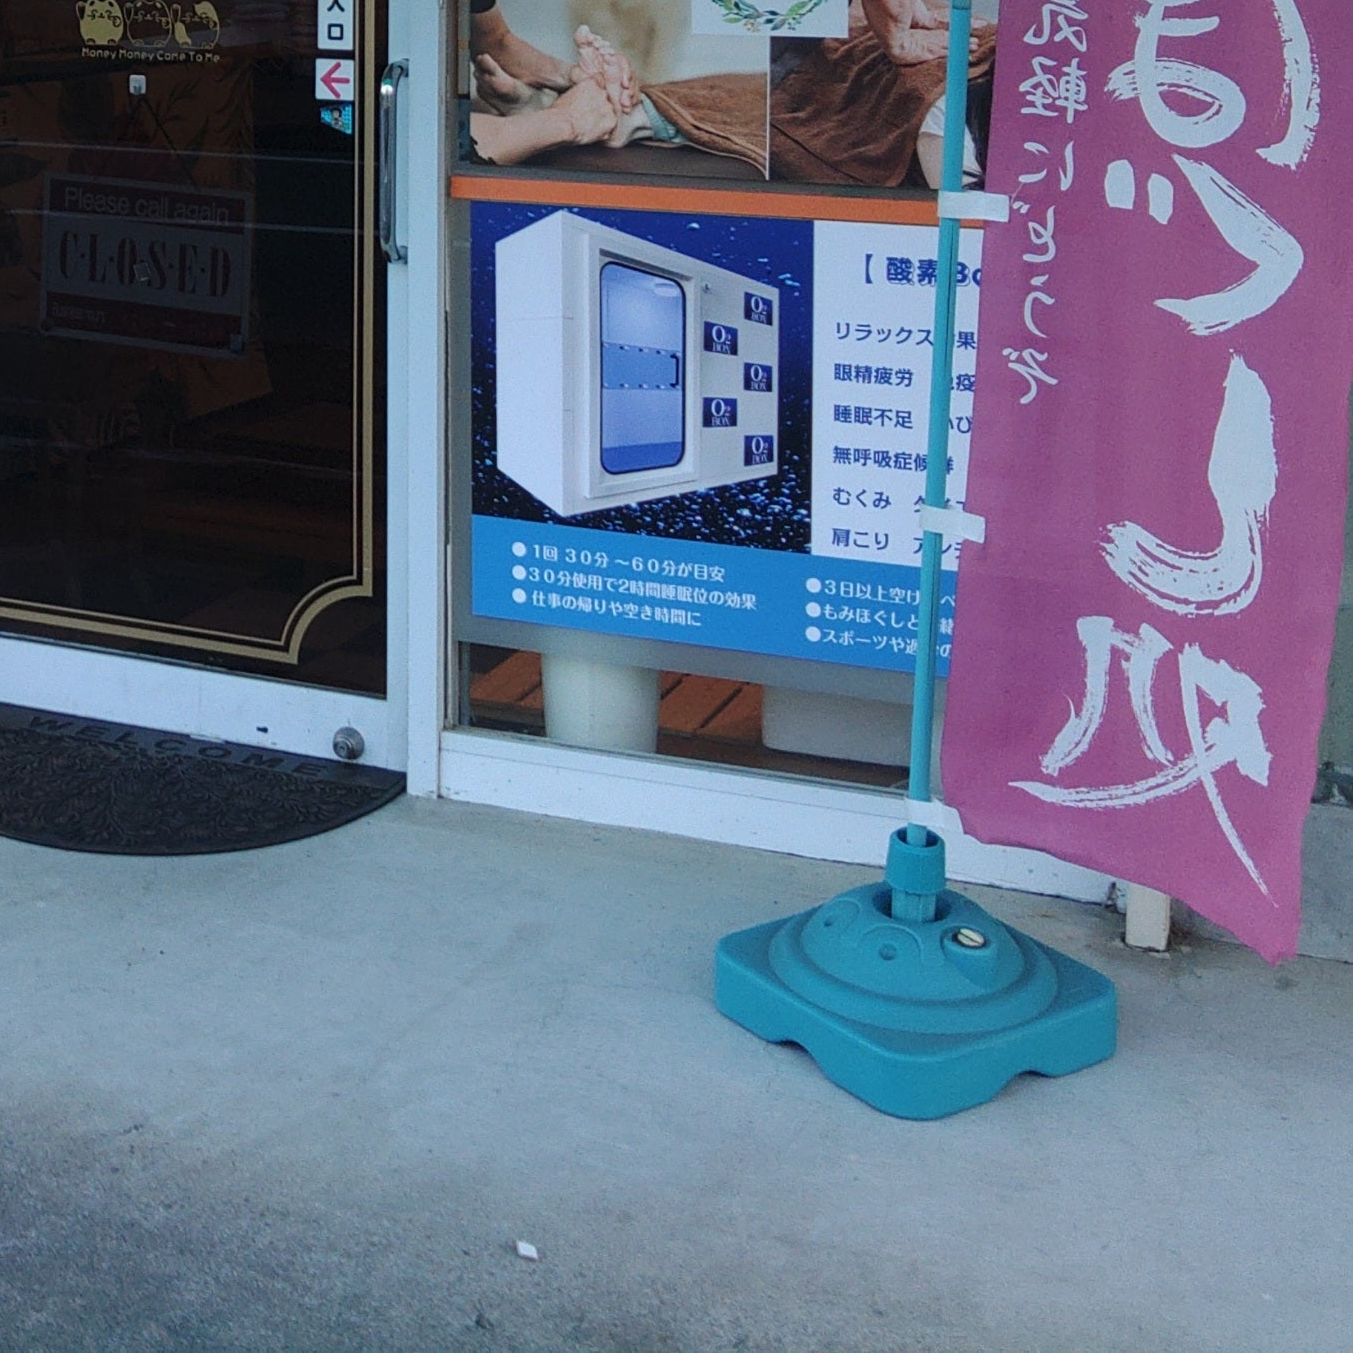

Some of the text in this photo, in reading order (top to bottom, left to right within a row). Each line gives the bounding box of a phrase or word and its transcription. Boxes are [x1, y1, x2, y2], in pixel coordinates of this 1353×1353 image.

[834, 363, 913, 387] 眼精疲労
[833, 404, 913, 430] 睡眠不足
[833, 446, 954, 475] 無呼吸症候
[833, 487, 891, 509] むくみ
[832, 528, 889, 550] 肩こり
[27, 716, 326, 776] WELCOME
